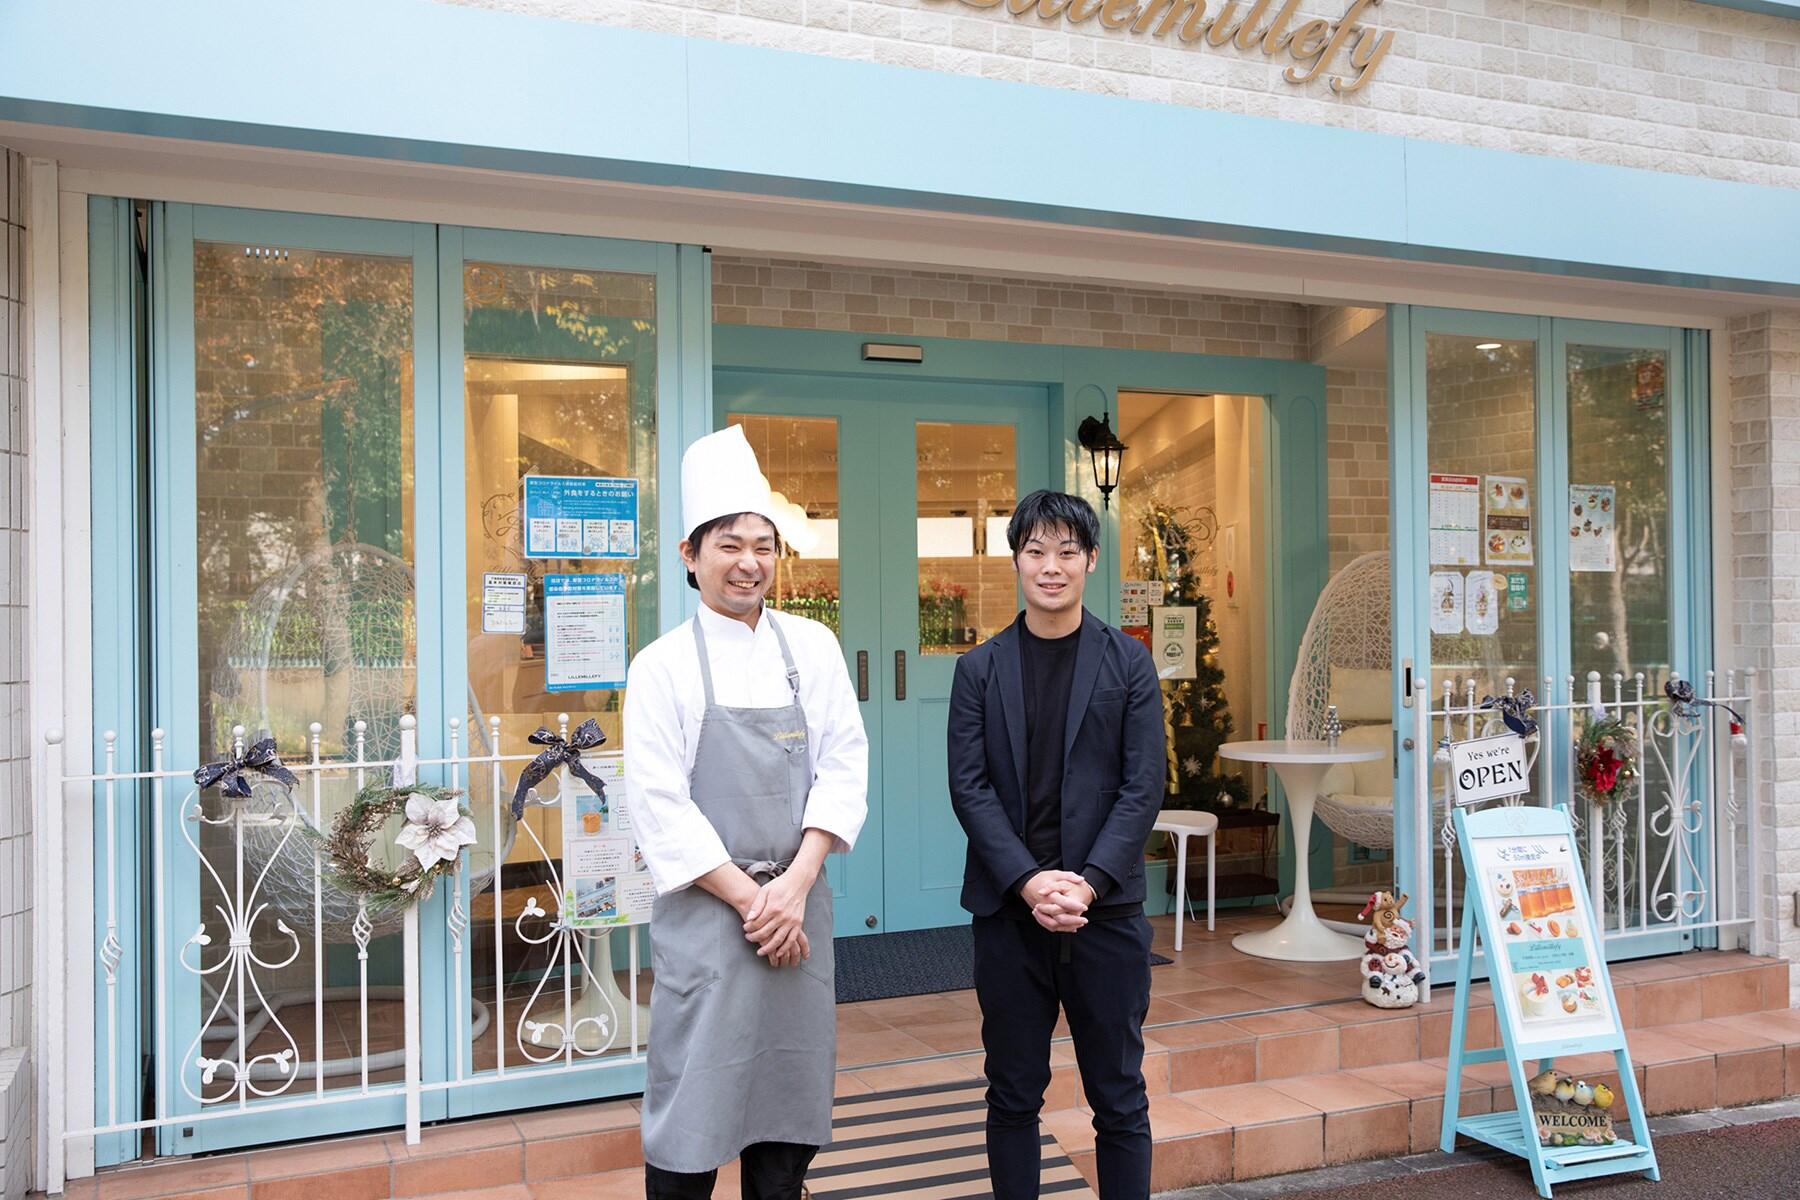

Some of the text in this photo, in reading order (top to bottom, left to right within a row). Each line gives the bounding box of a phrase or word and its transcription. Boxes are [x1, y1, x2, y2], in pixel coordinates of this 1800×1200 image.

[563, 489, 634, 498] 外食をするときのお願い
[1467, 746, 1510, 761] Yes we're
[1459, 760, 1523, 791] OPEN
[1539, 1114, 1608, 1128] WELCOME
